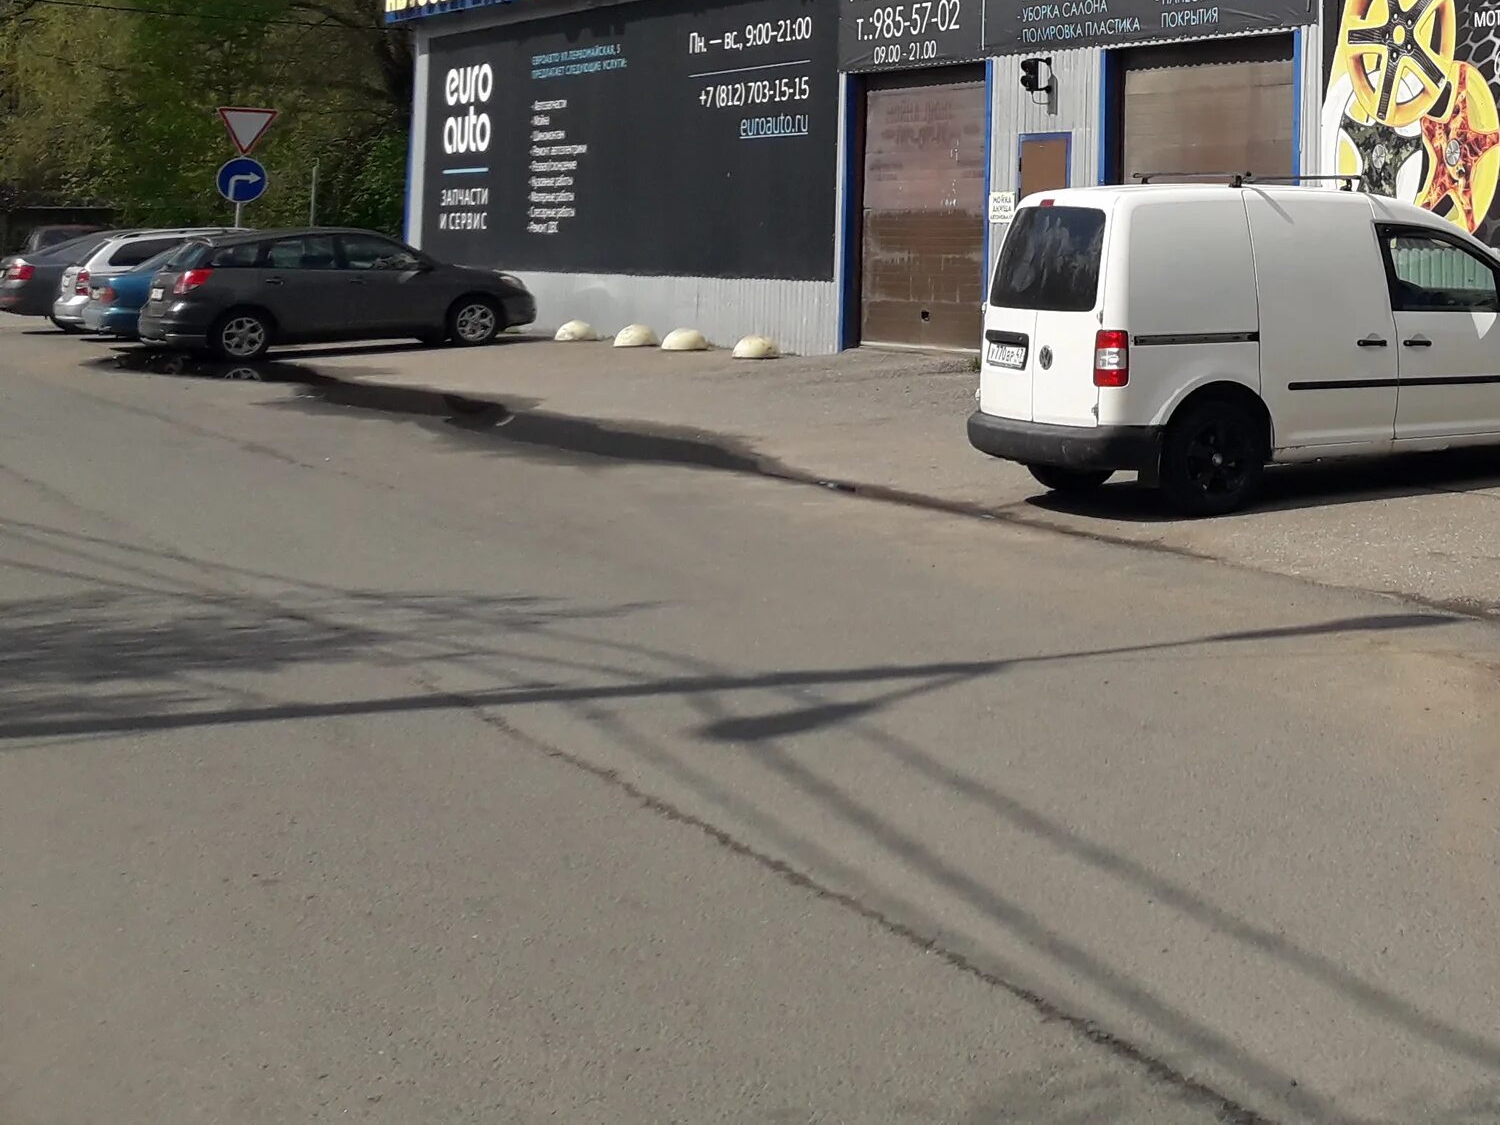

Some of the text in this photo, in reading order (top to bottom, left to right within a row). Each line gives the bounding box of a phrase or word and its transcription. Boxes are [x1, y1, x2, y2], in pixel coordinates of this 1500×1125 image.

[1022, 4, 1060, 22] УБОРКА
[1161, 7, 1219, 28] ПОКРЫТИЯ
[1022, 17, 1141, 43] ПОЛИРОВКА ПЛАСТИКА
[873, 44, 901, 65] 09.00
[908, 40, 937, 61] 21.00
[445, 63, 493, 106] euro
[699, 76, 810, 109] +7 (812) 703-15-15
[443, 106, 491, 154] auto
[740, 112, 809, 138] euroauto.ru
[439, 188, 488, 206] ЗАПЧАСТИ
[440, 213, 488, 230] И СЕРВИС
